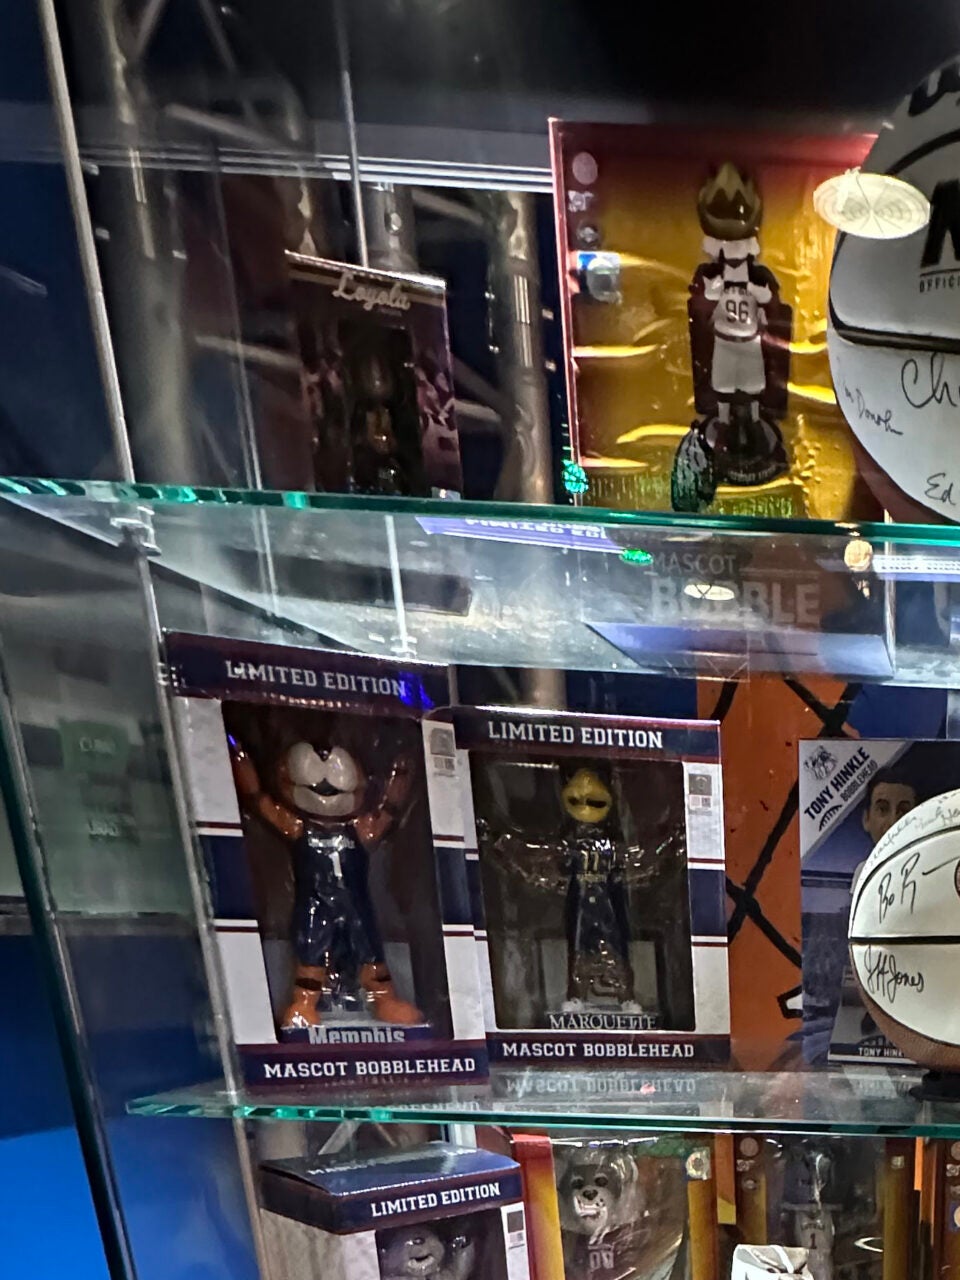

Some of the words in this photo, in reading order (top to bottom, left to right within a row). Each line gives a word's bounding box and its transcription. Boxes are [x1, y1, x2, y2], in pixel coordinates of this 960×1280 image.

[332, 274, 411, 312] Loyola
[648, 552, 737, 575] MASCOT
[225, 660, 318, 688] LIMITED
[323, 672, 407, 697] EDITION
[488, 720, 575, 744] LIMITED
[582, 727, 664, 749] EDITION
[804, 785, 834, 820] TONY
[830, 746, 870, 792] HINKLE
[550, 1013, 657, 1030] MARQUETTE
[502, 1042, 577, 1057] MASCOT
[583, 1042, 695, 1058] BOBBLEHEAD
[858, 1047, 881, 1057] TONY
[263, 1060, 348, 1078] MASCOT
[355, 1057, 476, 1076] BOBBLEHEAD
[371, 1194, 439, 1219] LIMITED
[441, 1182, 501, 1207] EDITION
